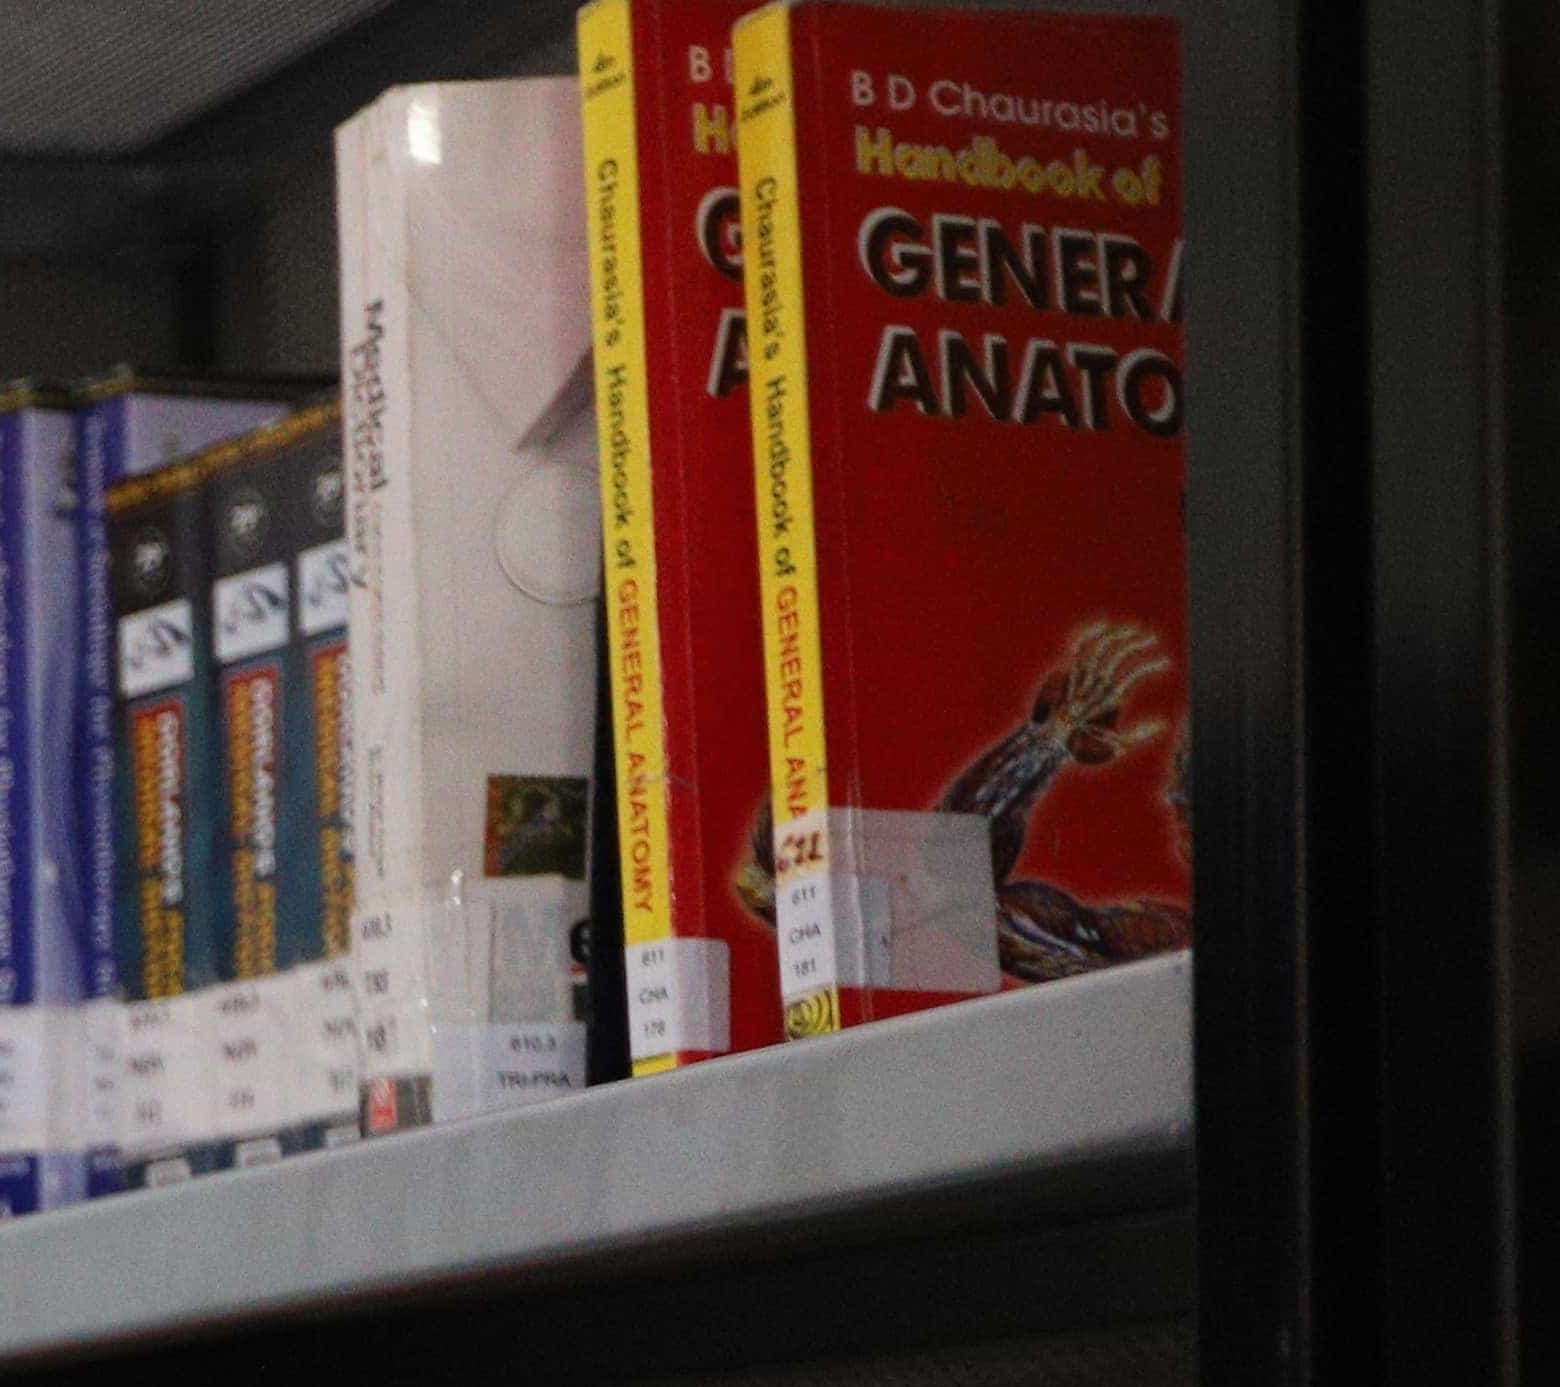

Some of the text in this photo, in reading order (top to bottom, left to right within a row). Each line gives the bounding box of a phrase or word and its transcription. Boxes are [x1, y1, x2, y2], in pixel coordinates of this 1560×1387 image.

[851, 69, 1169, 139] B D Chaurasia's
[854, 125, 1163, 205] Handbook of
[596, 158, 654, 914] Chaurasia's Handbook of GENERAL ANATOMY
[754, 177, 805, 746] Chaurasia's Handbook of GENERAL
